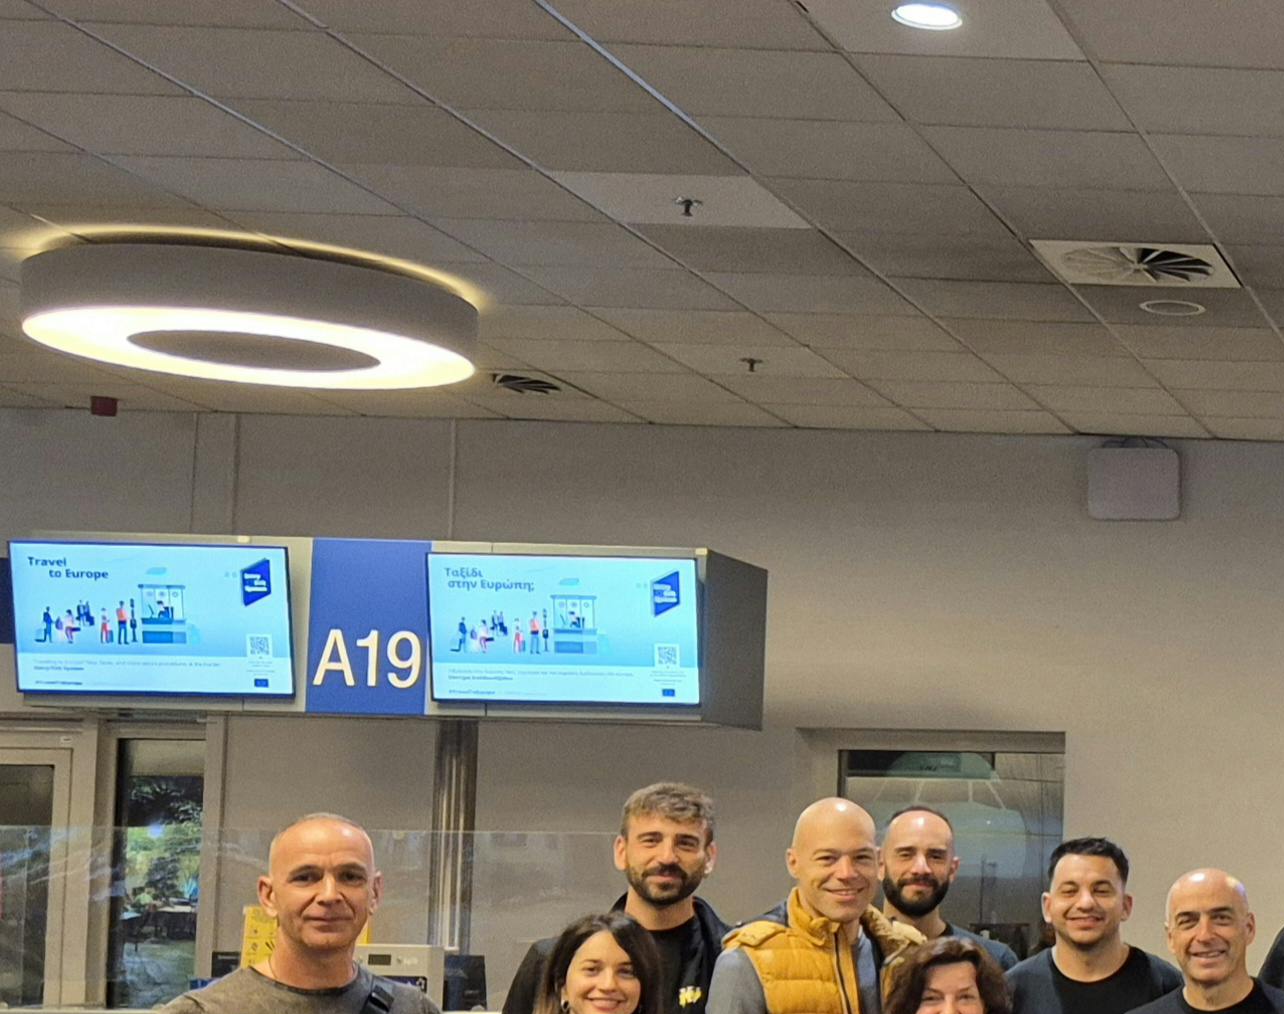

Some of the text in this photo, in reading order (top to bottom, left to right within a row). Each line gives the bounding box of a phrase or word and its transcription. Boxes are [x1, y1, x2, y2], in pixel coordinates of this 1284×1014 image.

[27, 556, 67, 567] Travel
[49, 568, 109, 581] to Europe
[444, 567, 483, 579] Ταξίδι
[447, 580, 477, 590] στην
[312, 628, 422, 689] A19
